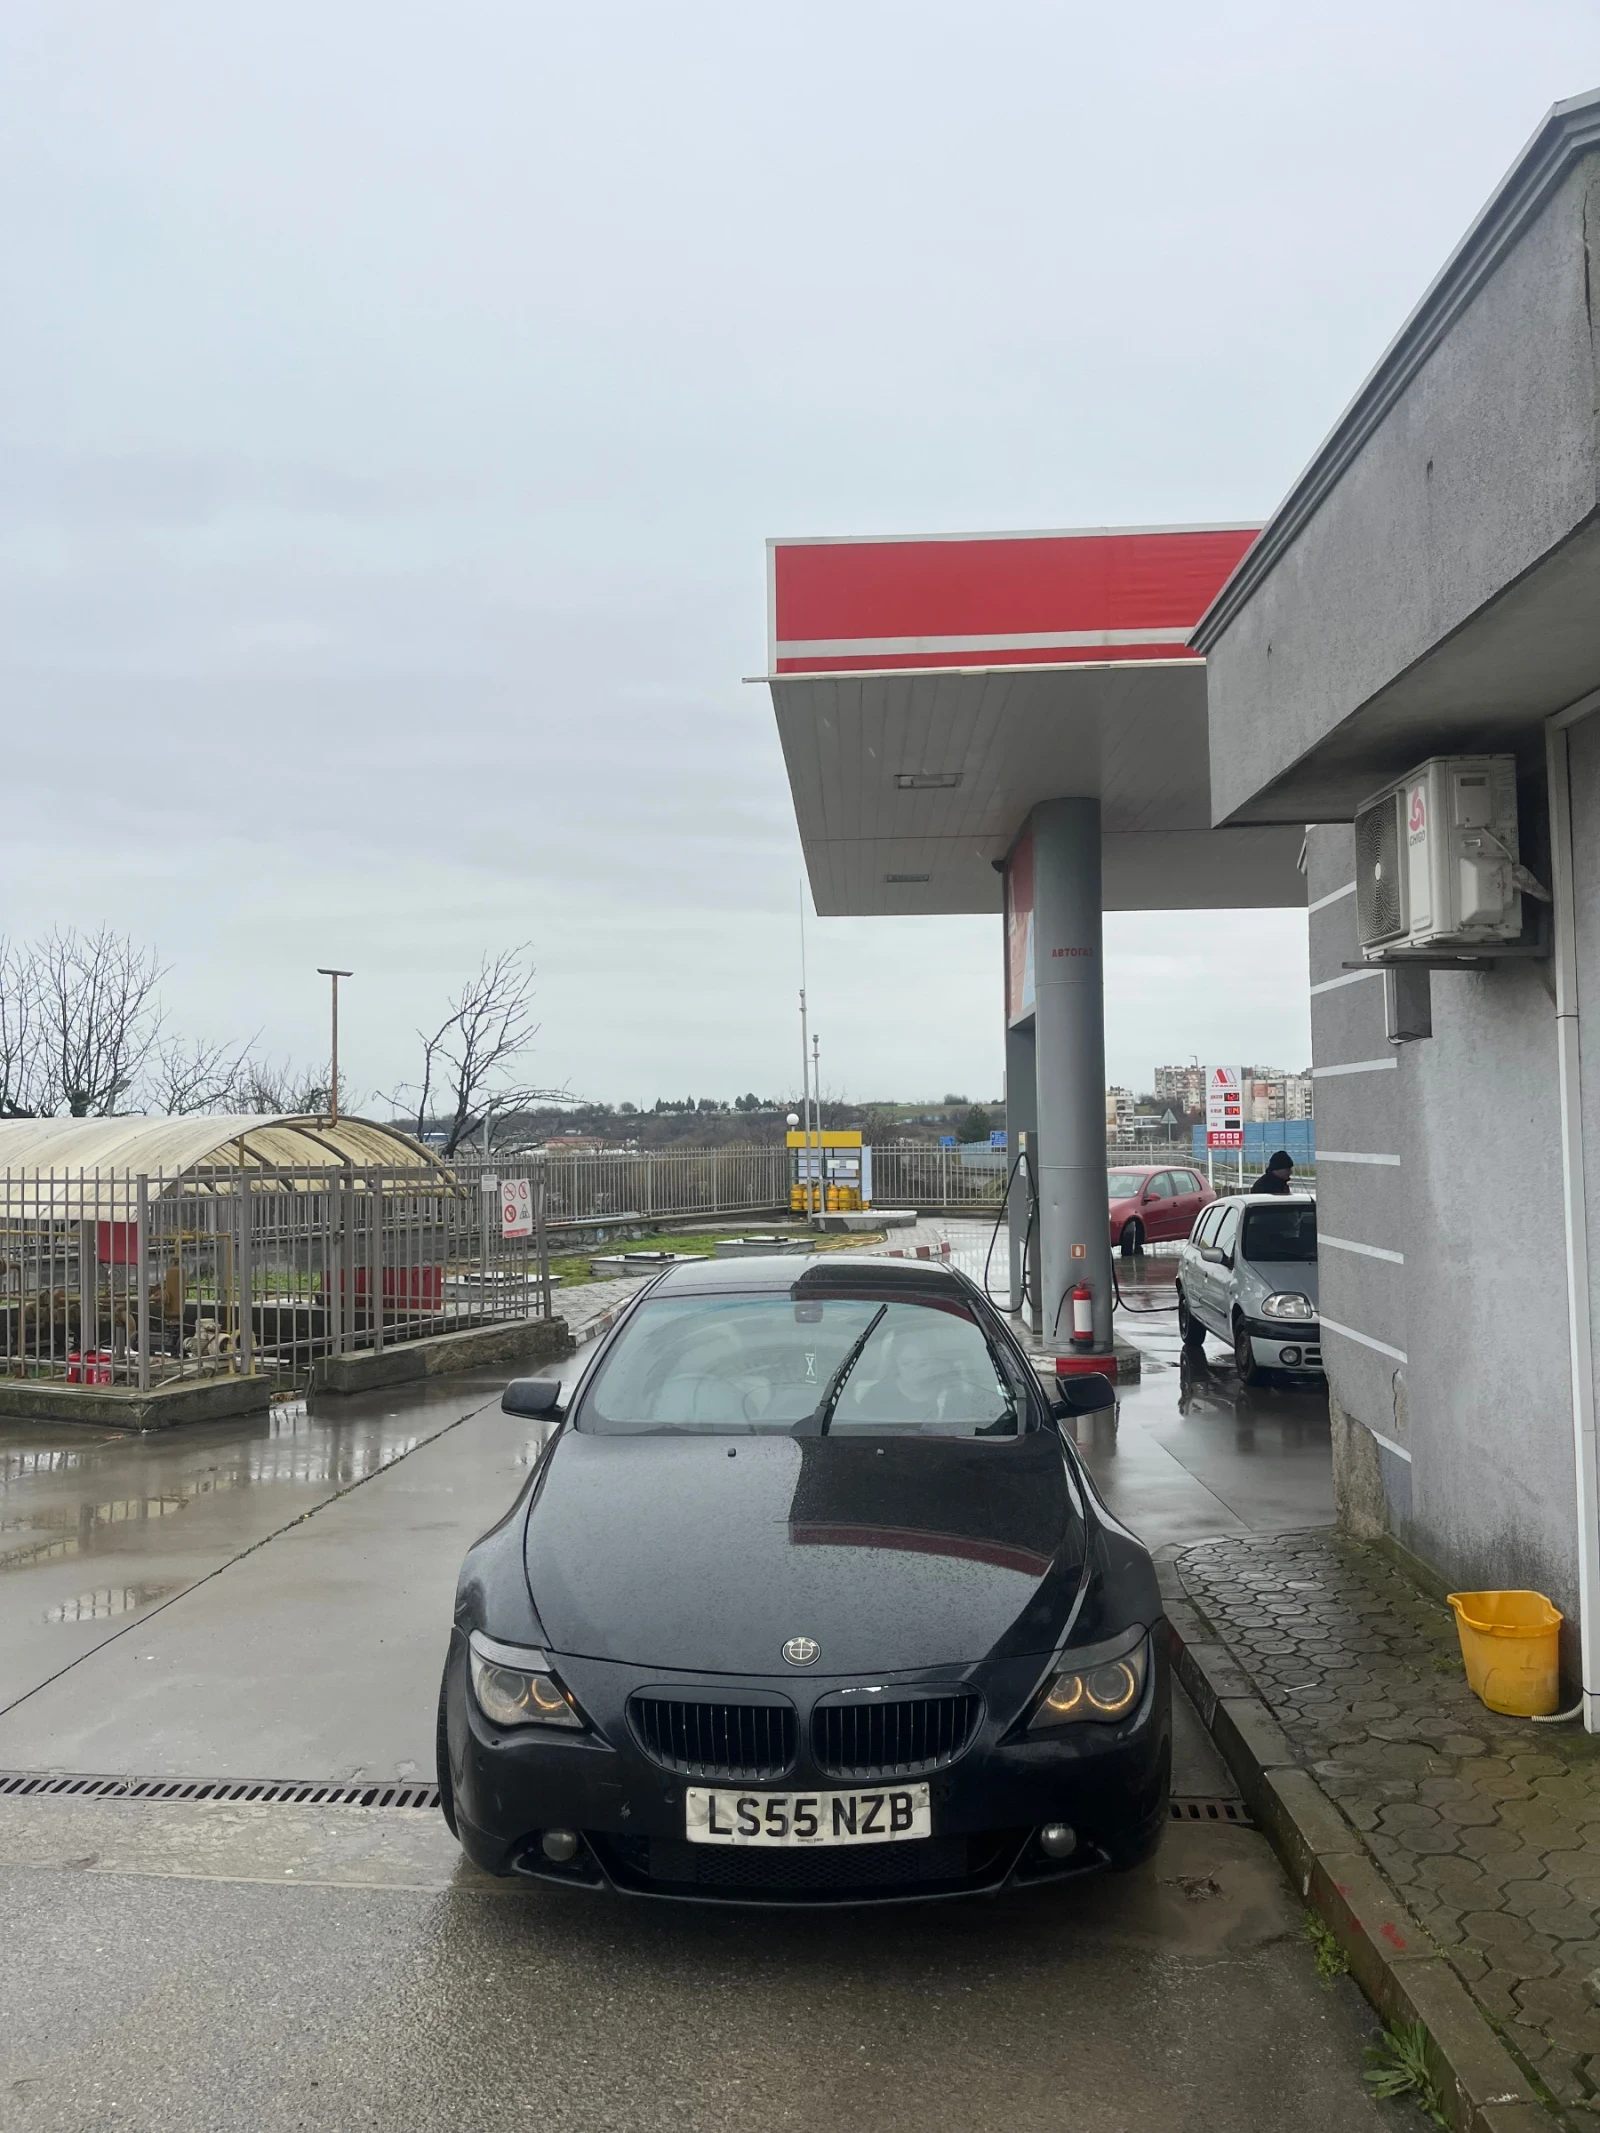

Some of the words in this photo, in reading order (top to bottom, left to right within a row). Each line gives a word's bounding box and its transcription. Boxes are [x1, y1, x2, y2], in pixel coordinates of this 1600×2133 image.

[1410, 829, 1425, 846] CHIGO
[1052, 947, 1093, 957] АВТОГАЗ
[708, 1795, 818, 1837] LS55
[833, 1792, 913, 1835] NZB
